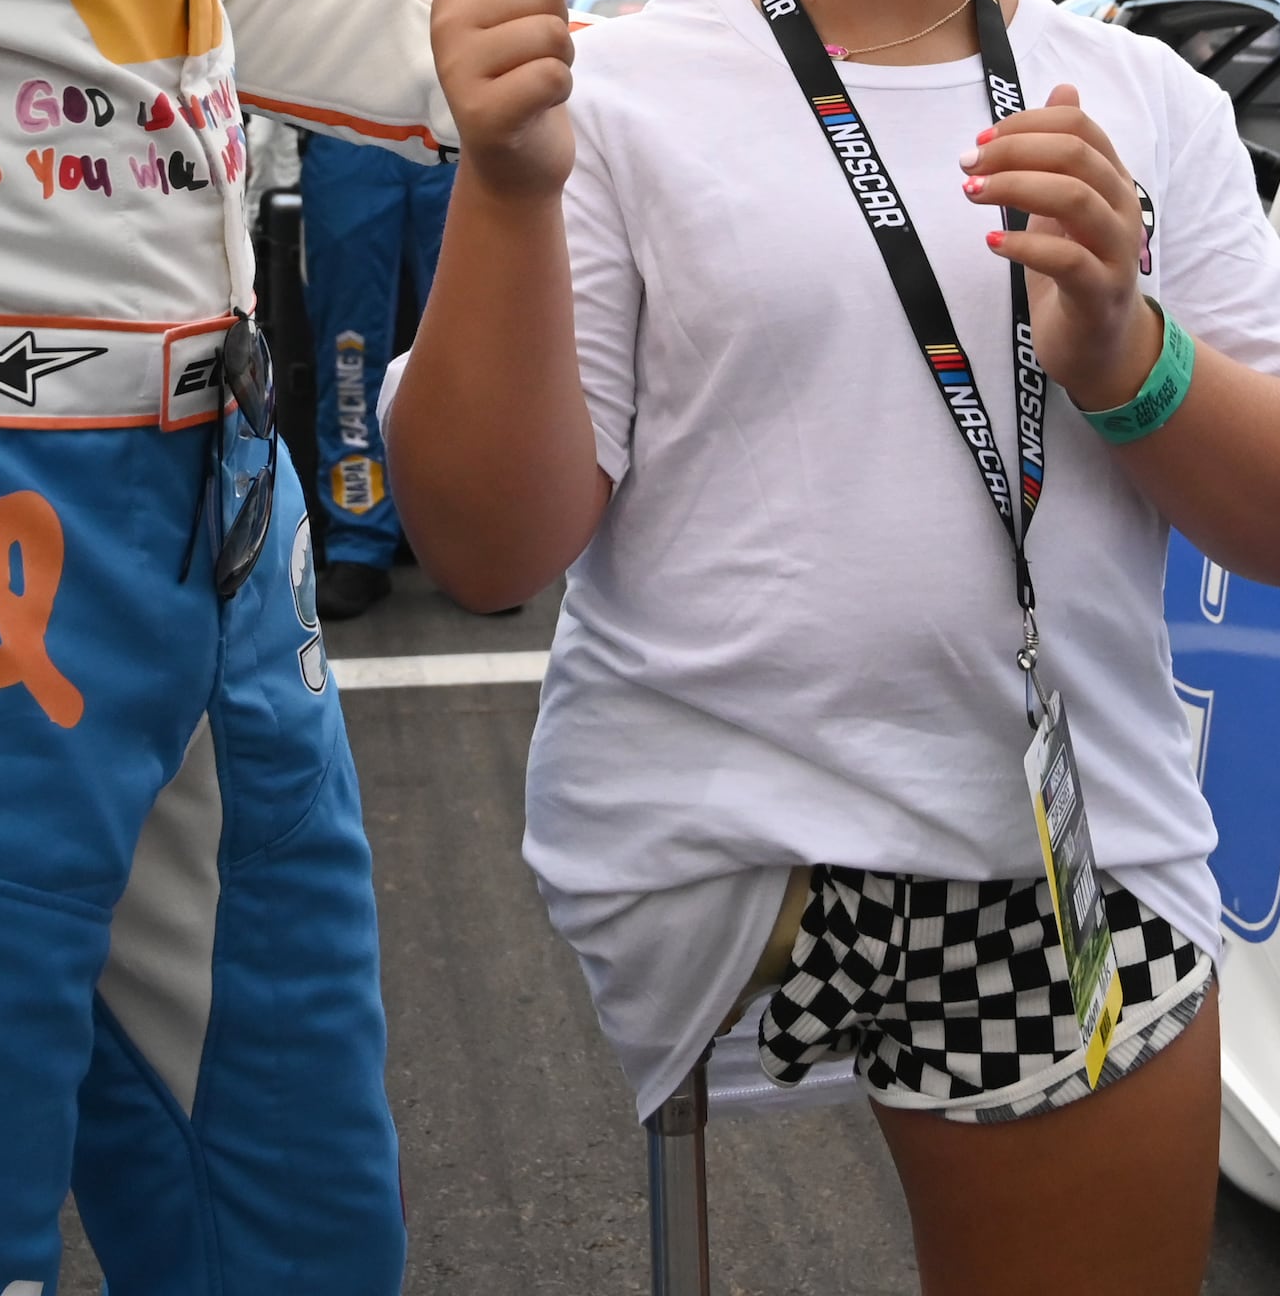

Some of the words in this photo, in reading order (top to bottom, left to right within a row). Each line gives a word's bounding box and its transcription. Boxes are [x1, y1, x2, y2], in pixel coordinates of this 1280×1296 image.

[826, 122, 906, 228] NASCAR
[1136, 375, 1175, 422] DRIVERS
[344, 459, 369, 504] NAPA
[943, 385, 1012, 517] NASCAR
